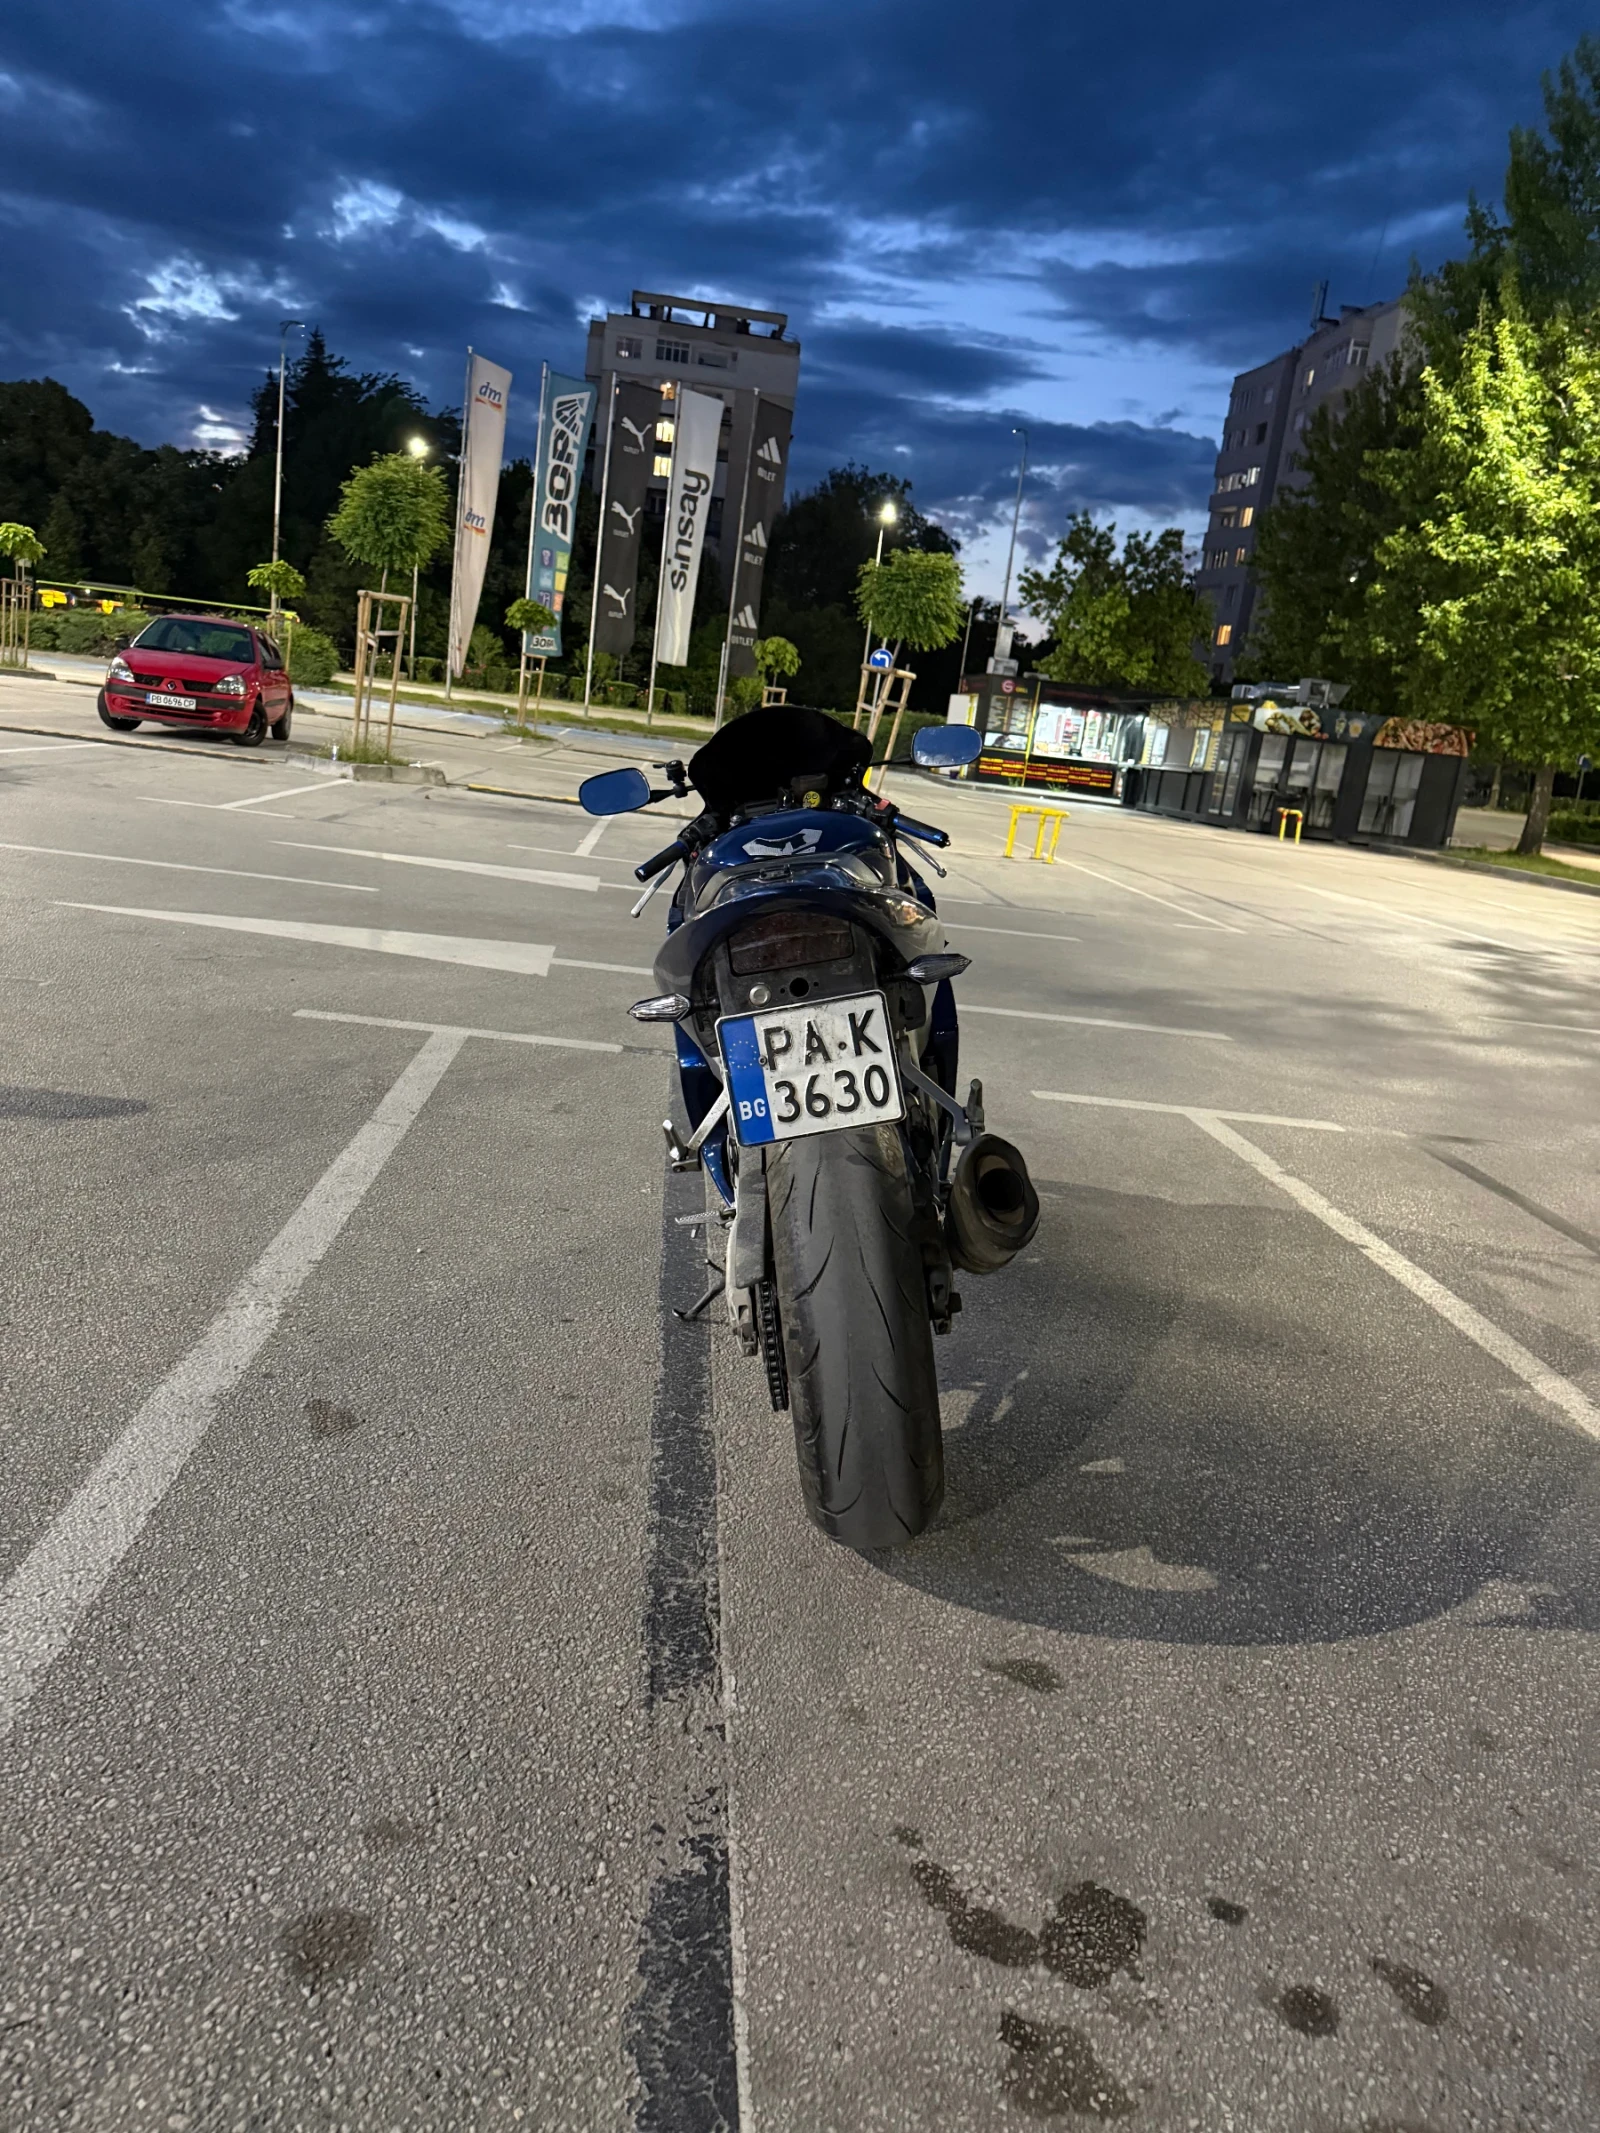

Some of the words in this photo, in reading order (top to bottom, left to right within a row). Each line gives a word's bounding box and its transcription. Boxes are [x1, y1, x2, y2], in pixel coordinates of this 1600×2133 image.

[479, 382, 502, 402] dm
[757, 466, 777, 483] LET
[465, 507, 485, 528] dm
[667, 468, 711, 593] sinsay
[151, 695, 162, 704] PB
[163, 696, 182, 706] 0696
[183, 699, 195, 708] CP
[774, 1064, 890, 1123] 3630
[738, 1098, 766, 1121] BG
